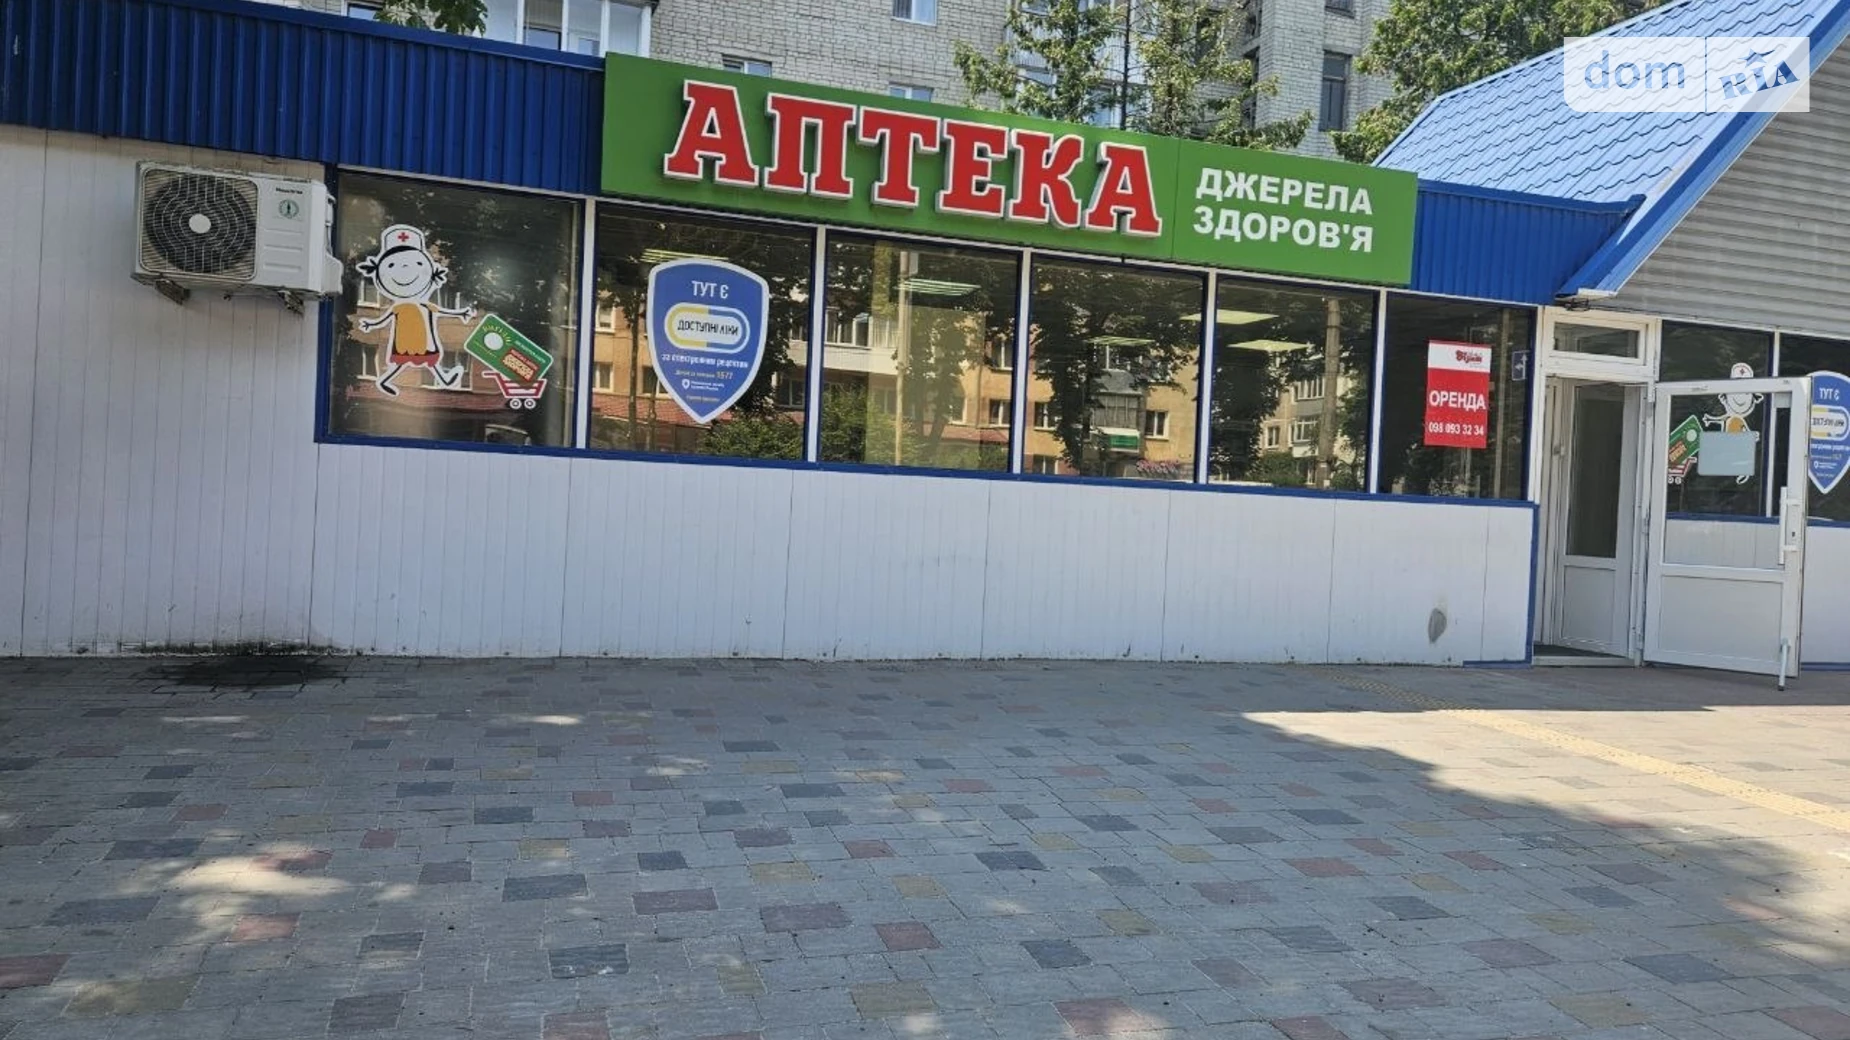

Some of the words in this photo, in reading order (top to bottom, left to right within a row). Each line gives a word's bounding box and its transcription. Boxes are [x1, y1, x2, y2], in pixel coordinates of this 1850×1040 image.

[663, 79, 1163, 237] АПТЕКА
[1195, 167, 1373, 215] ДЖЕРЕЛА
[1193, 205, 1373, 253] ЗДОРОВ'Я
[691, 280, 717, 298] ТУТ
[720, 284, 730, 300] Є
[1429, 390, 1487, 412] ОРЕНДА
[1462, 424, 1473, 436] 32
[1473, 425, 1485, 437] 34
